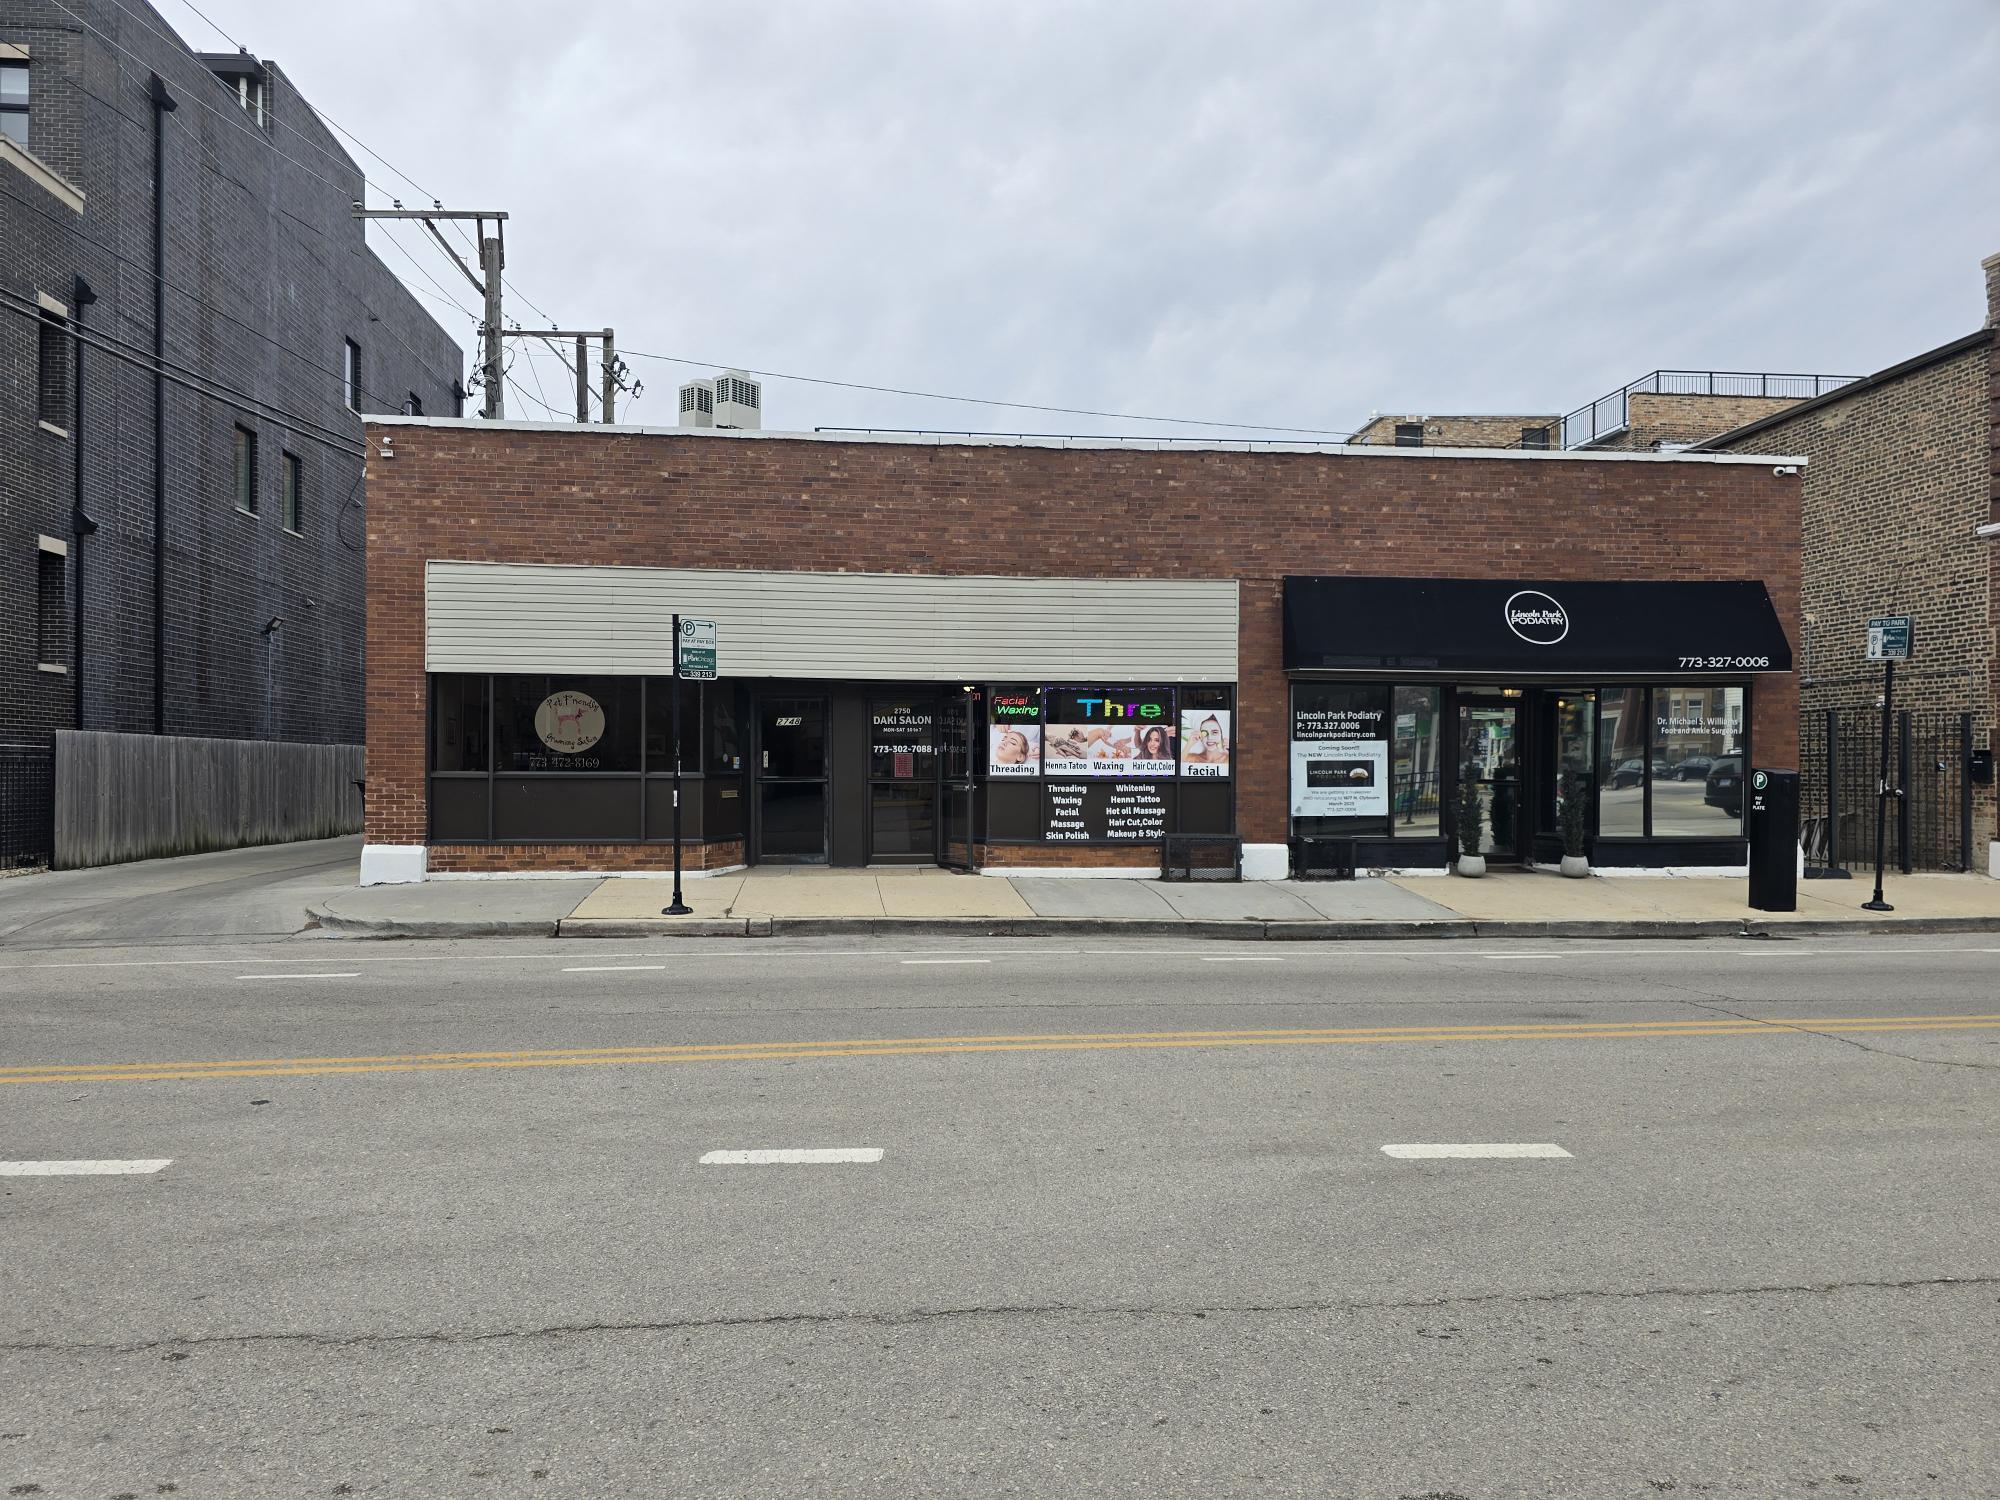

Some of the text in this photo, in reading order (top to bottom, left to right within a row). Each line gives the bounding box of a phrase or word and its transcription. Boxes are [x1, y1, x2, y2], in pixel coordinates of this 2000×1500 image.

[1511, 609, 1562, 618] Lincoln Park
[1510, 617, 1564, 625] PODIATRY
[1678, 656, 1769, 668] 773-327-0006
[546, 697, 562, 709] Pet
[994, 696, 1029, 705] Facial
[894, 707, 911, 715] 2750
[997, 705, 1039, 716] Waxing
[1076, 698, 1162, 719] Thre
[873, 715, 897, 725] DAKI
[899, 715, 932, 725] SALON
[1296, 711, 1382, 722] Lincoln Park Podiatry
[1657, 717, 1738, 725] Dr. Michael S. Williams
[1296, 722, 1360, 730] P: 773.327.0006
[1296, 731, 1376, 739] lincolnparkpodiatry.com
[1711, 727, 1738, 736] Surgeon
[873, 745, 932, 754] 773-302-7088
[530, 757, 547, 768] 773
[1045, 761, 1088, 770] Henna Tatoo
[1093, 761, 1124, 773] Waxing
[1132, 761, 1175, 772] Hair Cut,Color
[990, 764, 1035, 775] Threading
[1187, 765, 1220, 777] facial
[1756, 774, 1764, 787] P
[1047, 784, 1088, 794] Threading
[1115, 784, 1156, 794] Whitening
[1052, 796, 1083, 806] Waxing
[1110, 795, 1161, 804] Henna Tattoo
[1055, 807, 1080, 817] Facial
[1106, 807, 1166, 816] Hot oil Massage
[1050, 820, 1085, 830] Massage
[1108, 818, 1164, 828] Hair Cut,Color
[1045, 831, 1090, 840] Skin Polish
[1107, 829, 1137, 839] Makeup
[1138, 829, 1144, 838] &
